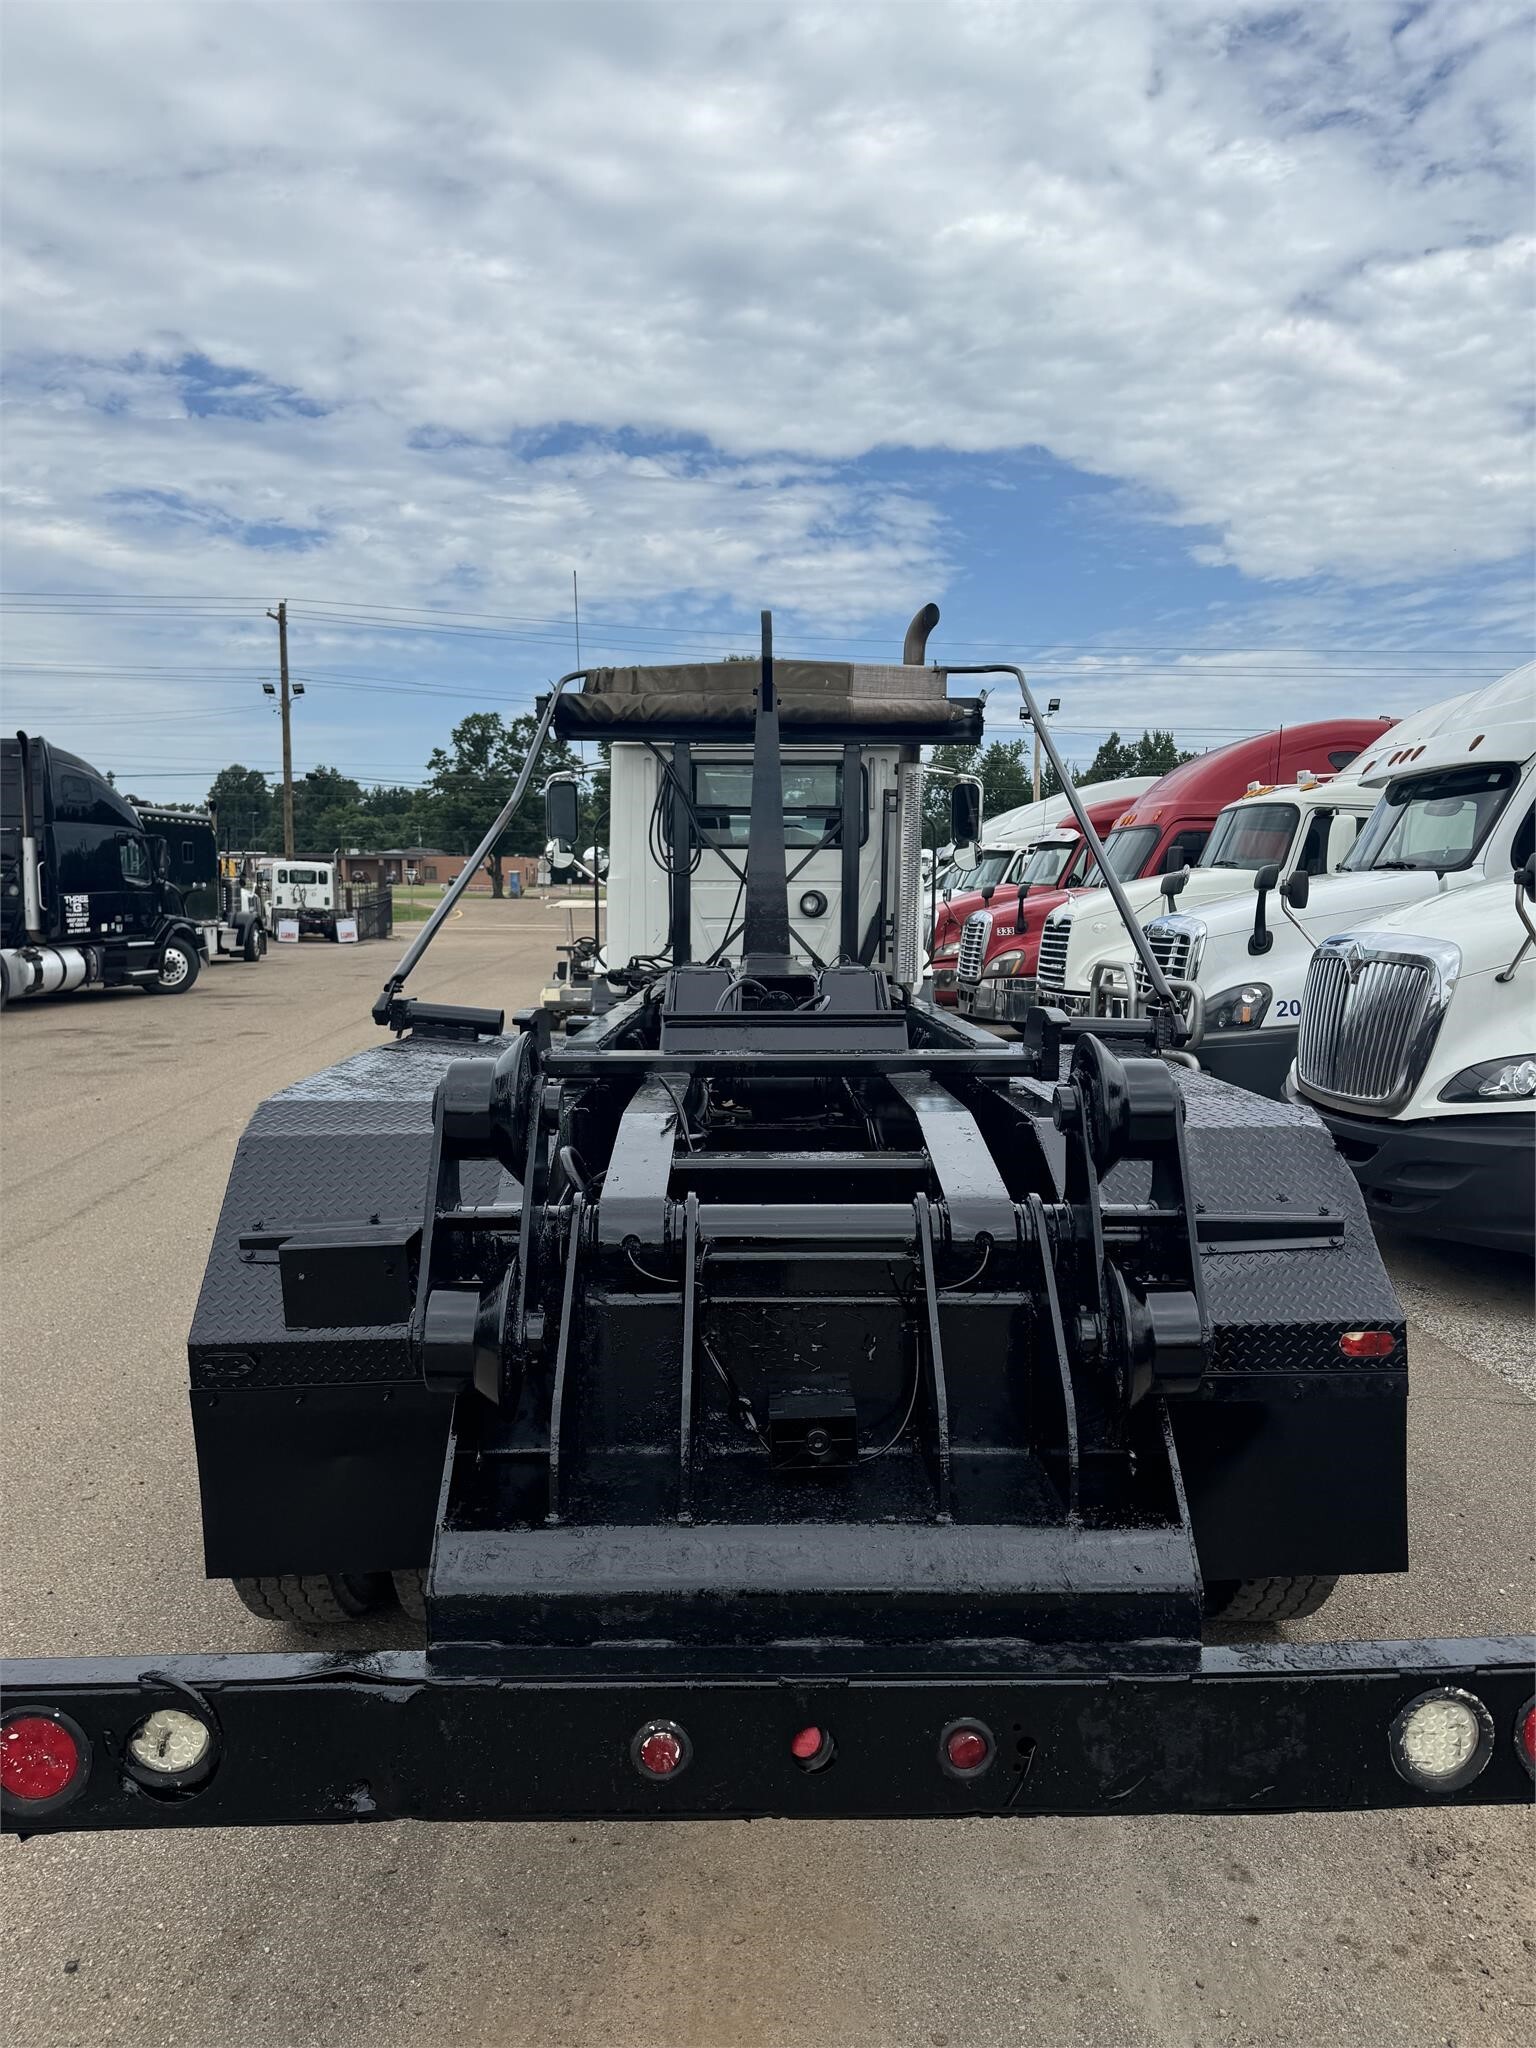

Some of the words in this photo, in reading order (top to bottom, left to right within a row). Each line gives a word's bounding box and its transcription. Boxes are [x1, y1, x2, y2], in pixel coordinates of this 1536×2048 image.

[64, 894, 89, 905] THREE
[998, 927, 1014, 935] 333
[1276, 999, 1301, 1018] 20
